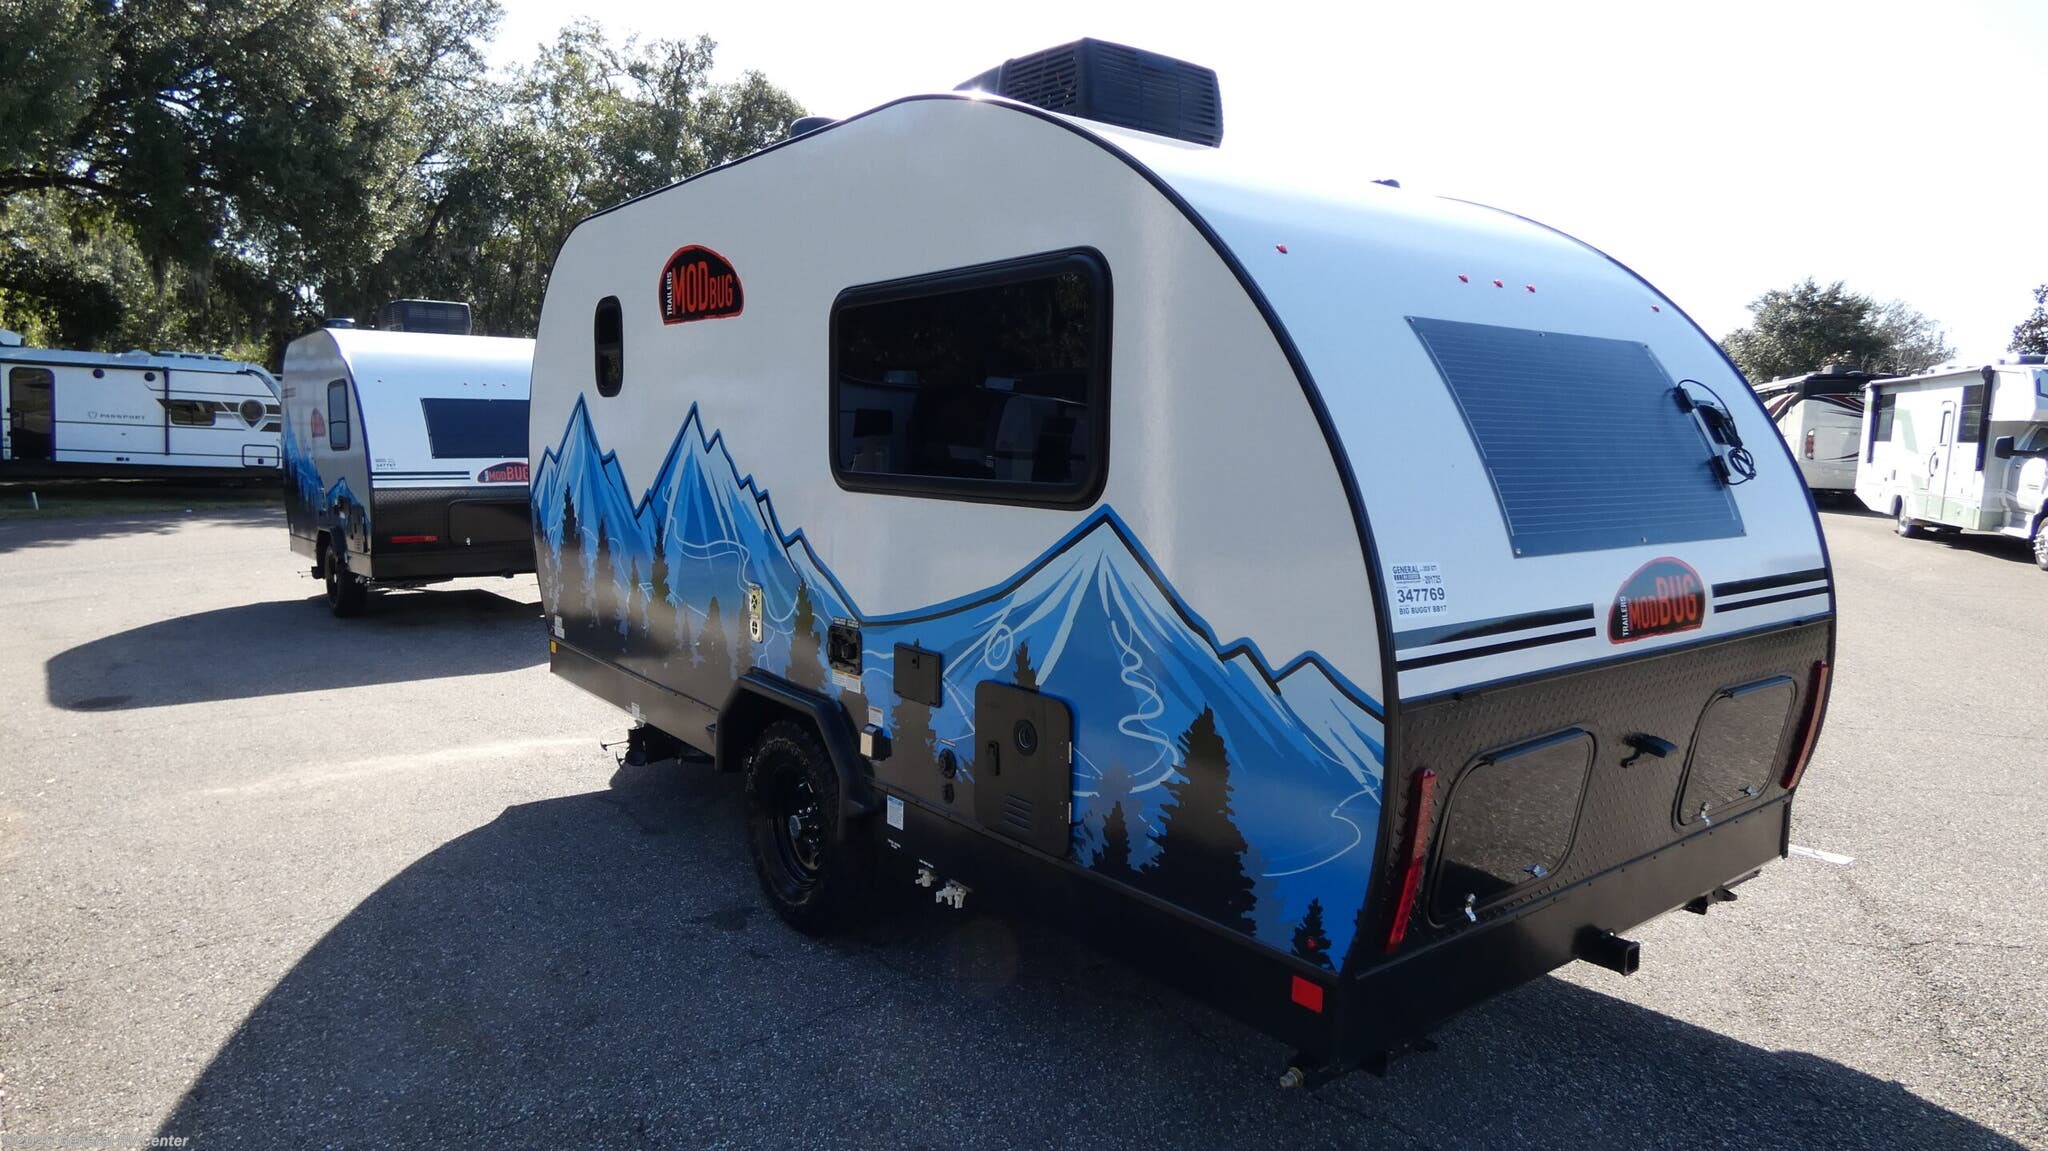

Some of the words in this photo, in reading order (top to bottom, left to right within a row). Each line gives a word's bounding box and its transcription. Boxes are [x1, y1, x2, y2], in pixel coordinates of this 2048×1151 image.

[1392, 565, 1420, 574] GENERAL
[1397, 587, 1445, 603] 347769
[1399, 607, 1410, 616] BIG
[1411, 606, 1431, 615] BUGGY
[1619, 594, 1630, 637] TRAILERS
